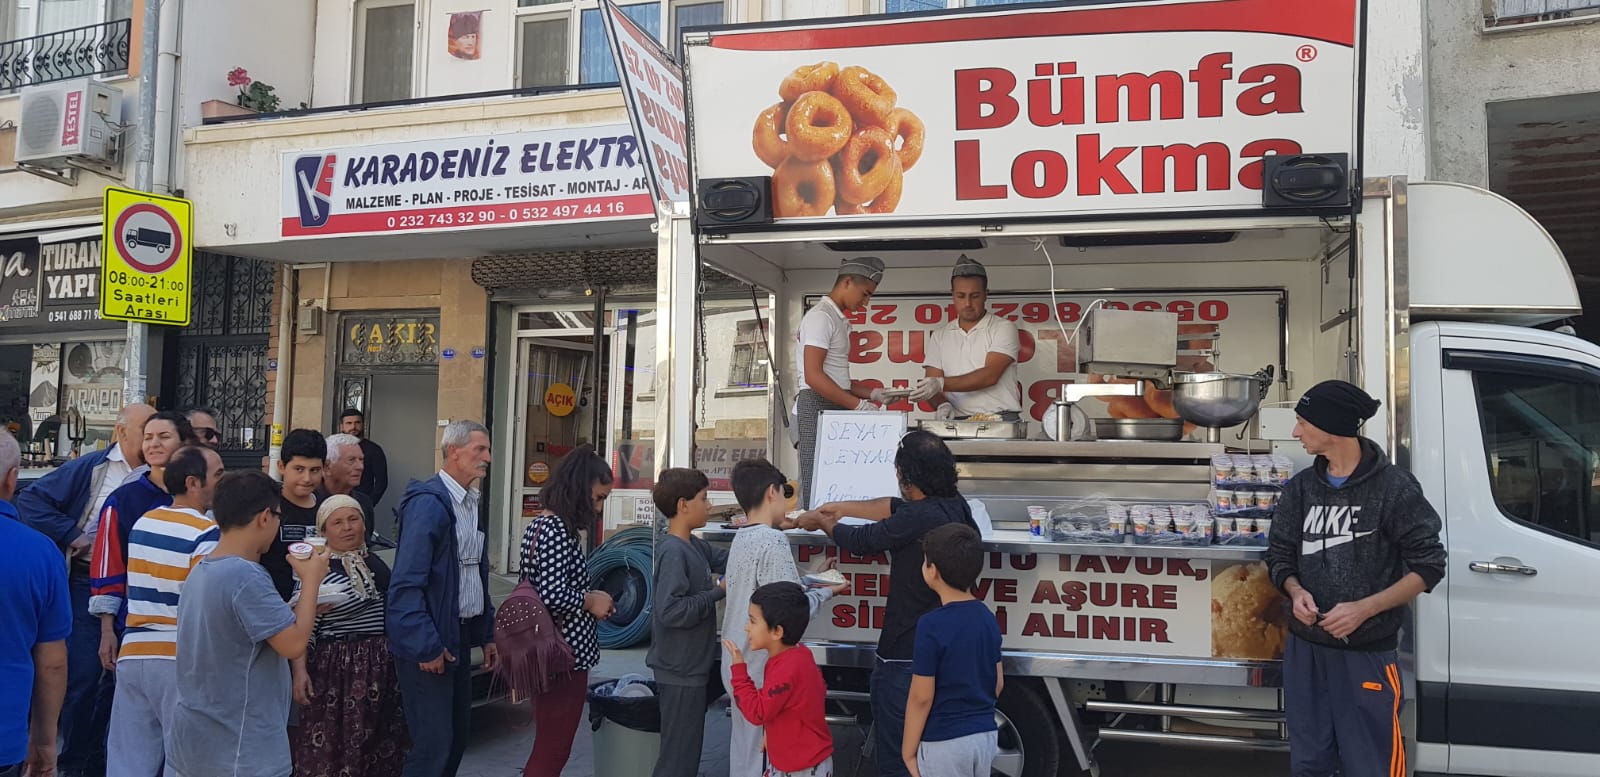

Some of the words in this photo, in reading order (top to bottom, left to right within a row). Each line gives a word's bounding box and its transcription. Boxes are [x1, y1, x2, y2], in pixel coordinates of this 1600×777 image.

[954, 52, 1304, 131] Bümfa
[66, 91, 80, 143] VESTEL
[344, 139, 510, 188] KARADENİZ
[346, 195, 401, 210] MALZEME
[412, 192, 443, 205] PLAN
[454, 188, 493, 203] PROJE
[505, 182, 556, 199] TESİSAT
[567, 178, 620, 195] MONTAJ
[387, 216, 395, 228] 0
[400, 214, 425, 228] 232
[429, 212, 453, 225] 743
[457, 211, 474, 224] 32
[478, 210, 496, 222] 90
[509, 208, 518, 220] 0
[522, 207, 548, 219] 532
[553, 204, 579, 217] 497
[584, 203, 602, 215] 44
[606, 201, 625, 214] 16
[43, 240, 102, 271] TURAN
[48, 273, 97, 299] YAPI
[109, 270, 184, 292] 08:00-21:00
[113, 289, 180, 307] Saatleri
[125, 300, 169, 320] Arası
[48, 312, 55, 323] 0
[54, 311, 68, 322] 541
[69, 310, 83, 321] 688
[84, 309, 93, 321] 71
[547, 392, 574, 408] AÇIK
[1302, 505, 1362, 536] NIKE
[1031, 579, 1178, 612] AŞURE
[1021, 612, 1174, 644] ALINIR
